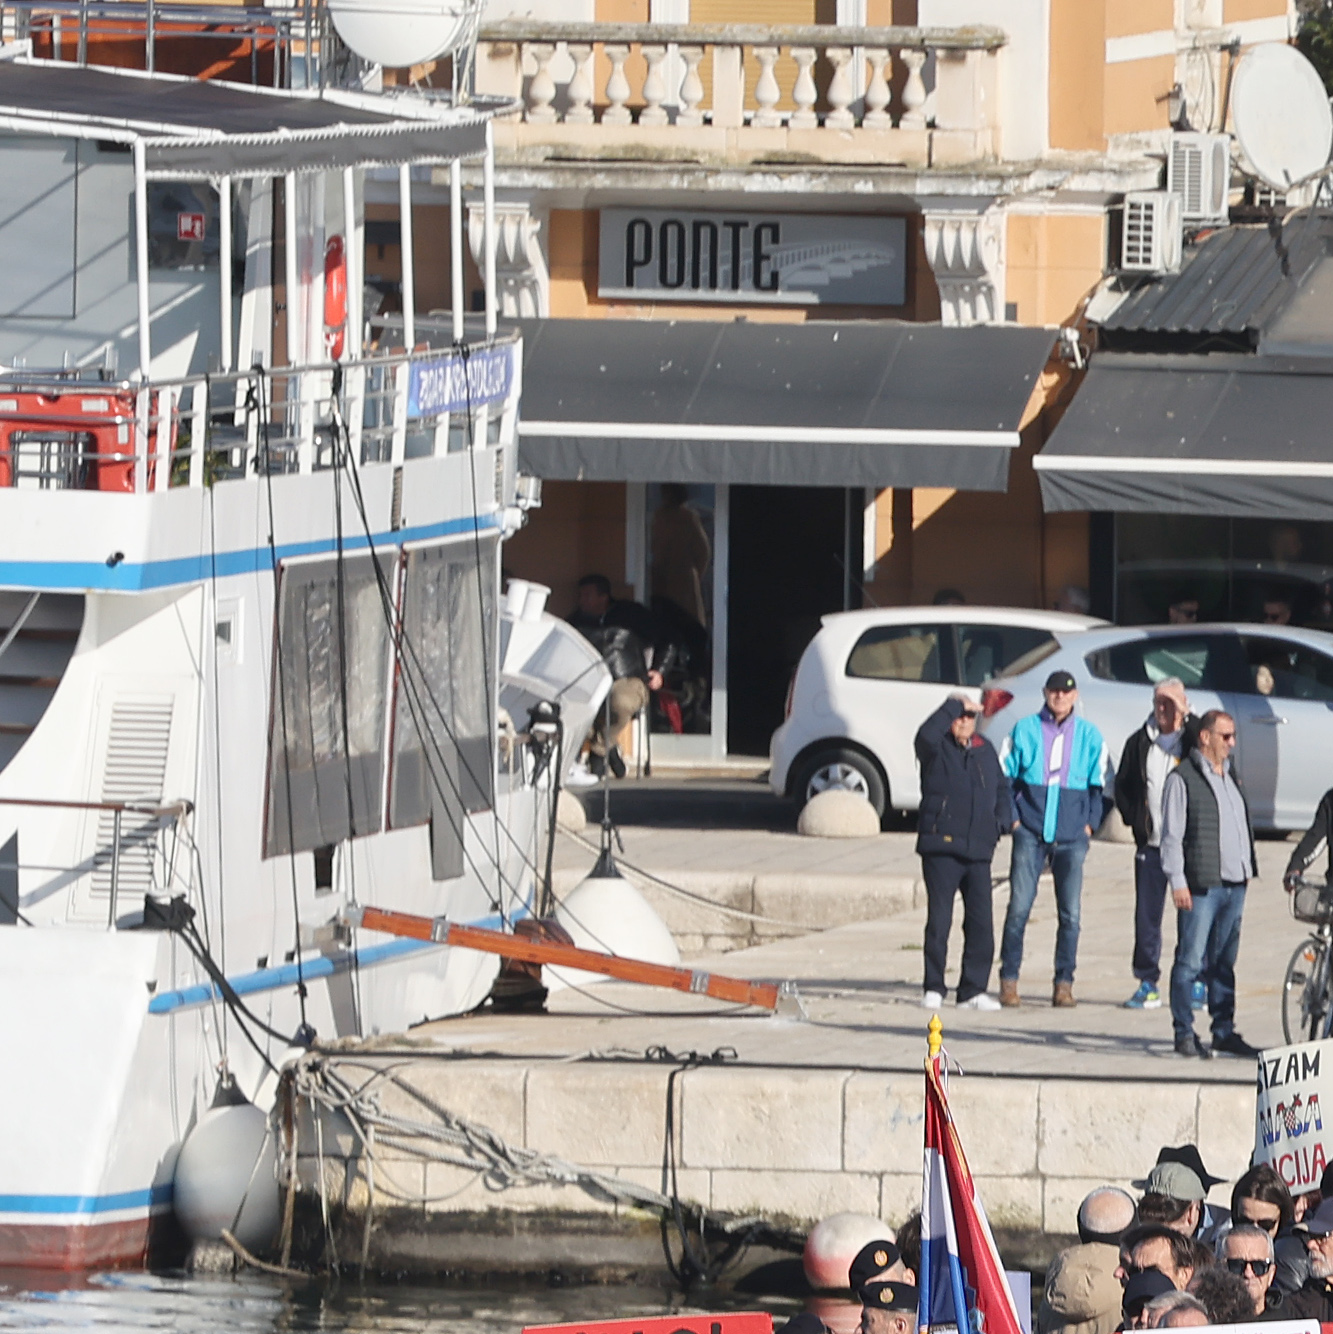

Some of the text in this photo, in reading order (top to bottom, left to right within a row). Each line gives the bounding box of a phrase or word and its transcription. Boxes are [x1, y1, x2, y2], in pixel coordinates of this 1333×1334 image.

[625, 217, 781, 292] PONTE
[1259, 1092, 1323, 1148] NAŠA
[1266, 1142, 1327, 1187] ICIJA
